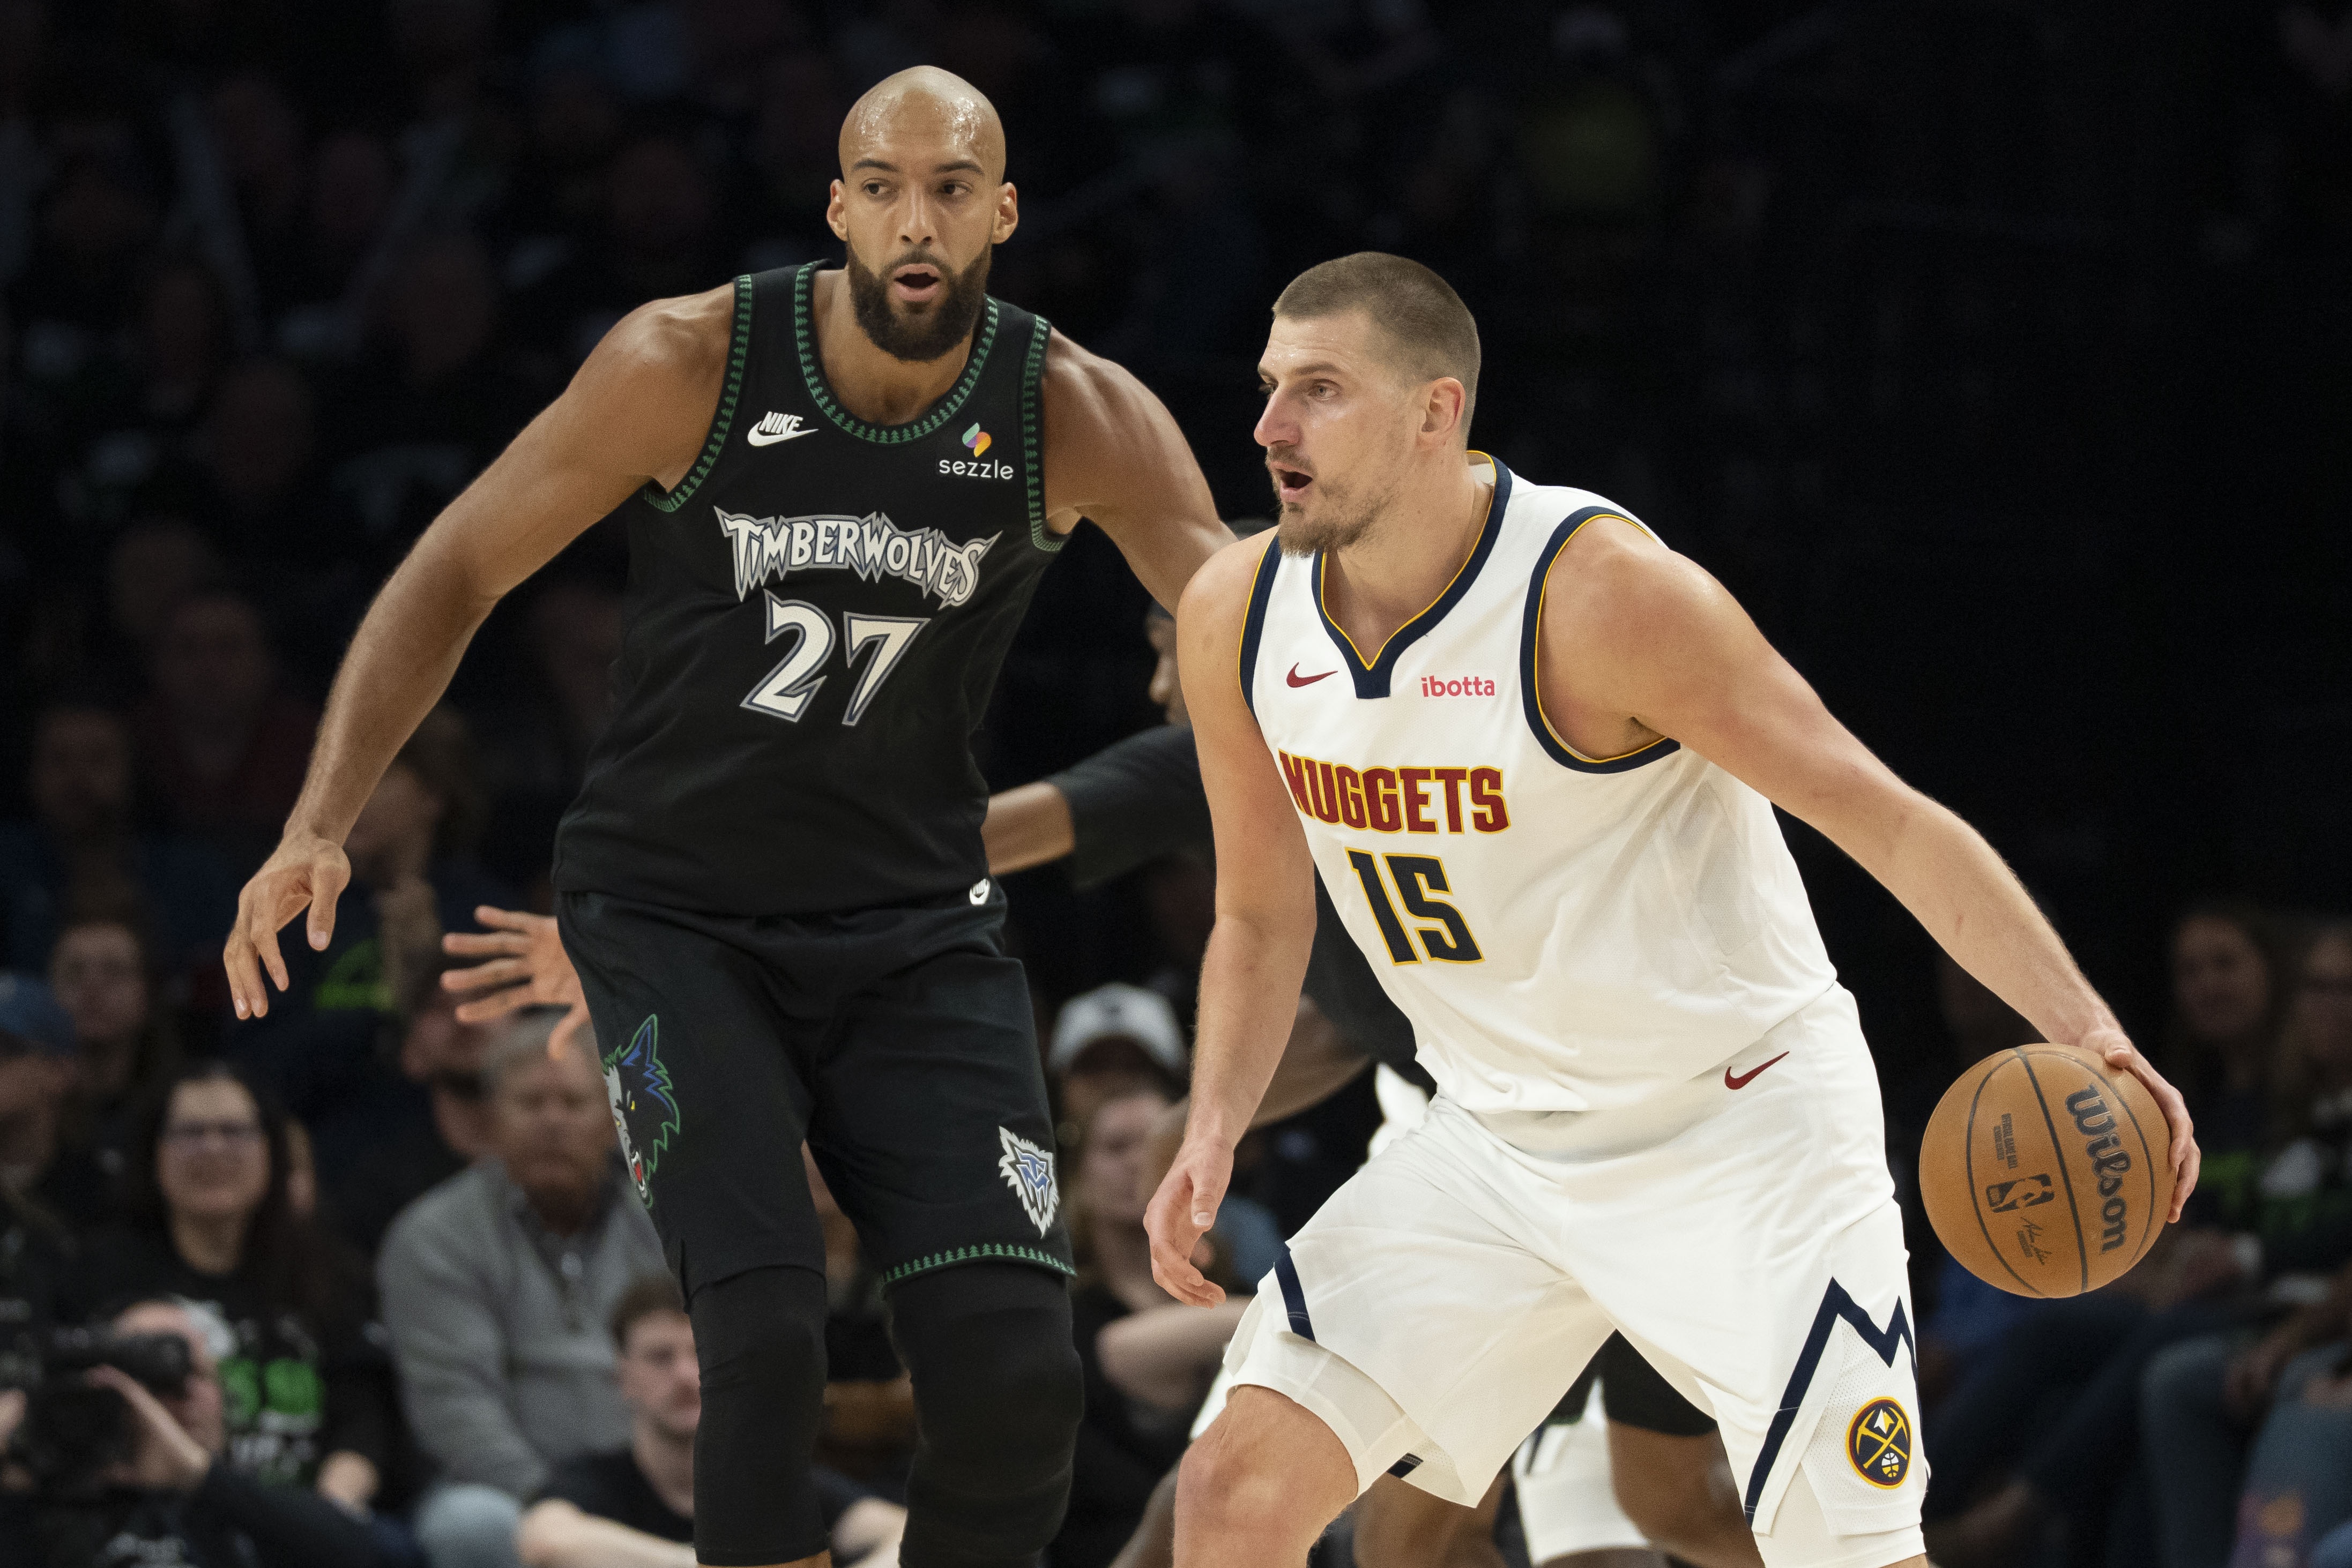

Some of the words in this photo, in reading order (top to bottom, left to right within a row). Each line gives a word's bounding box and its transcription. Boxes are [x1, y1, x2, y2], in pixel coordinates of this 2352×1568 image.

[759, 412, 803, 435] NIKE
[939, 458, 1014, 480] sezzle
[713, 505, 1003, 611] TIMBERWOLVES
[740, 587, 931, 726] 27
[1421, 675, 1495, 697] ibotta
[1278, 748, 1512, 835] NUGGETS
[1345, 847, 1485, 966] 15
[2065, 1082, 2132, 1255] Wilson
